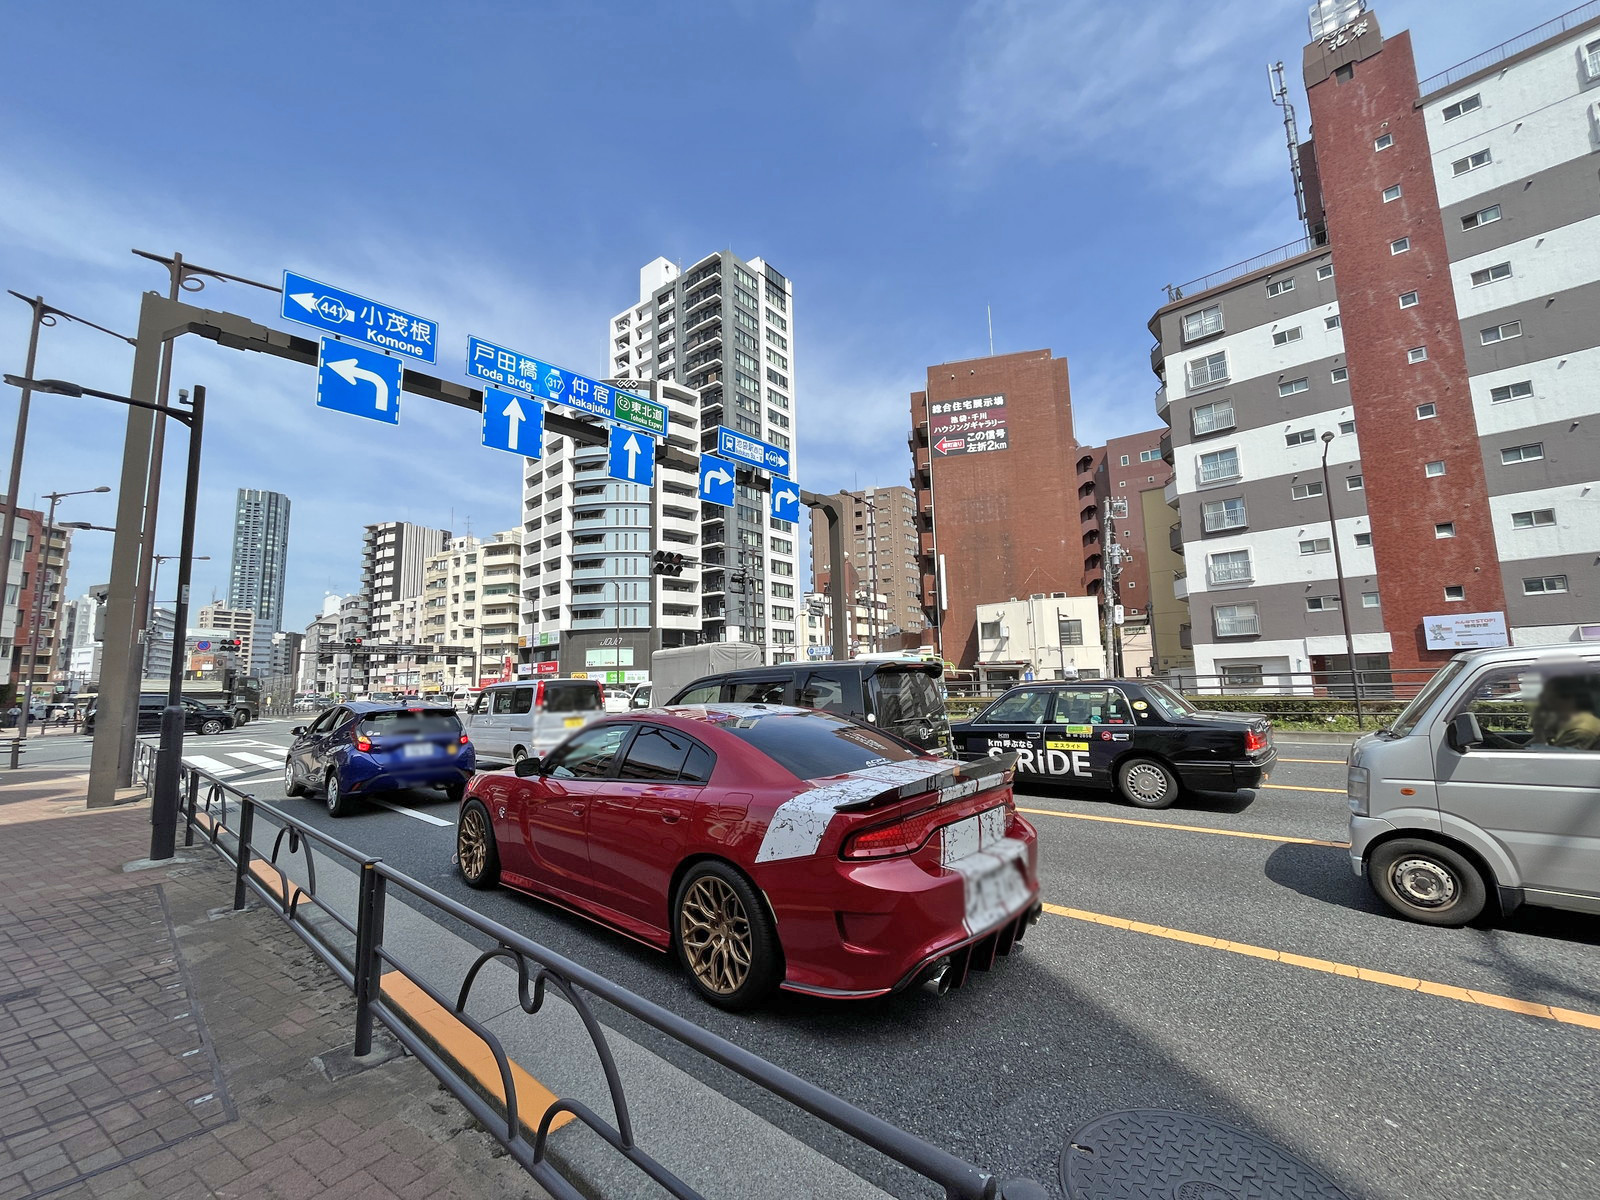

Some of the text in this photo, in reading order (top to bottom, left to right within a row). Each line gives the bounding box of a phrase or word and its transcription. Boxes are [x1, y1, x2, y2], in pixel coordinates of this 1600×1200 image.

[320, 301, 343, 318] 441
[359, 305, 432, 346] 小茂根
[367, 328, 424, 356] Komone
[474, 342, 538, 381] 戸田橋
[475, 363, 535, 393] Toda Brdg.
[547, 377, 562, 390] 317
[571, 376, 610, 405] 仲宿
[568, 394, 611, 417] Nakajuku
[619, 398, 629, 409] C2
[631, 401, 663, 422] 東北道
[932, 395, 1004, 414] 総合住宅展示場
[630, 414, 648, 426] Tohoku
[933, 419, 1006, 434] ハウジングギャラリー
[966, 428, 1006, 442] この信号
[966, 440, 1007, 453] 左折2km
